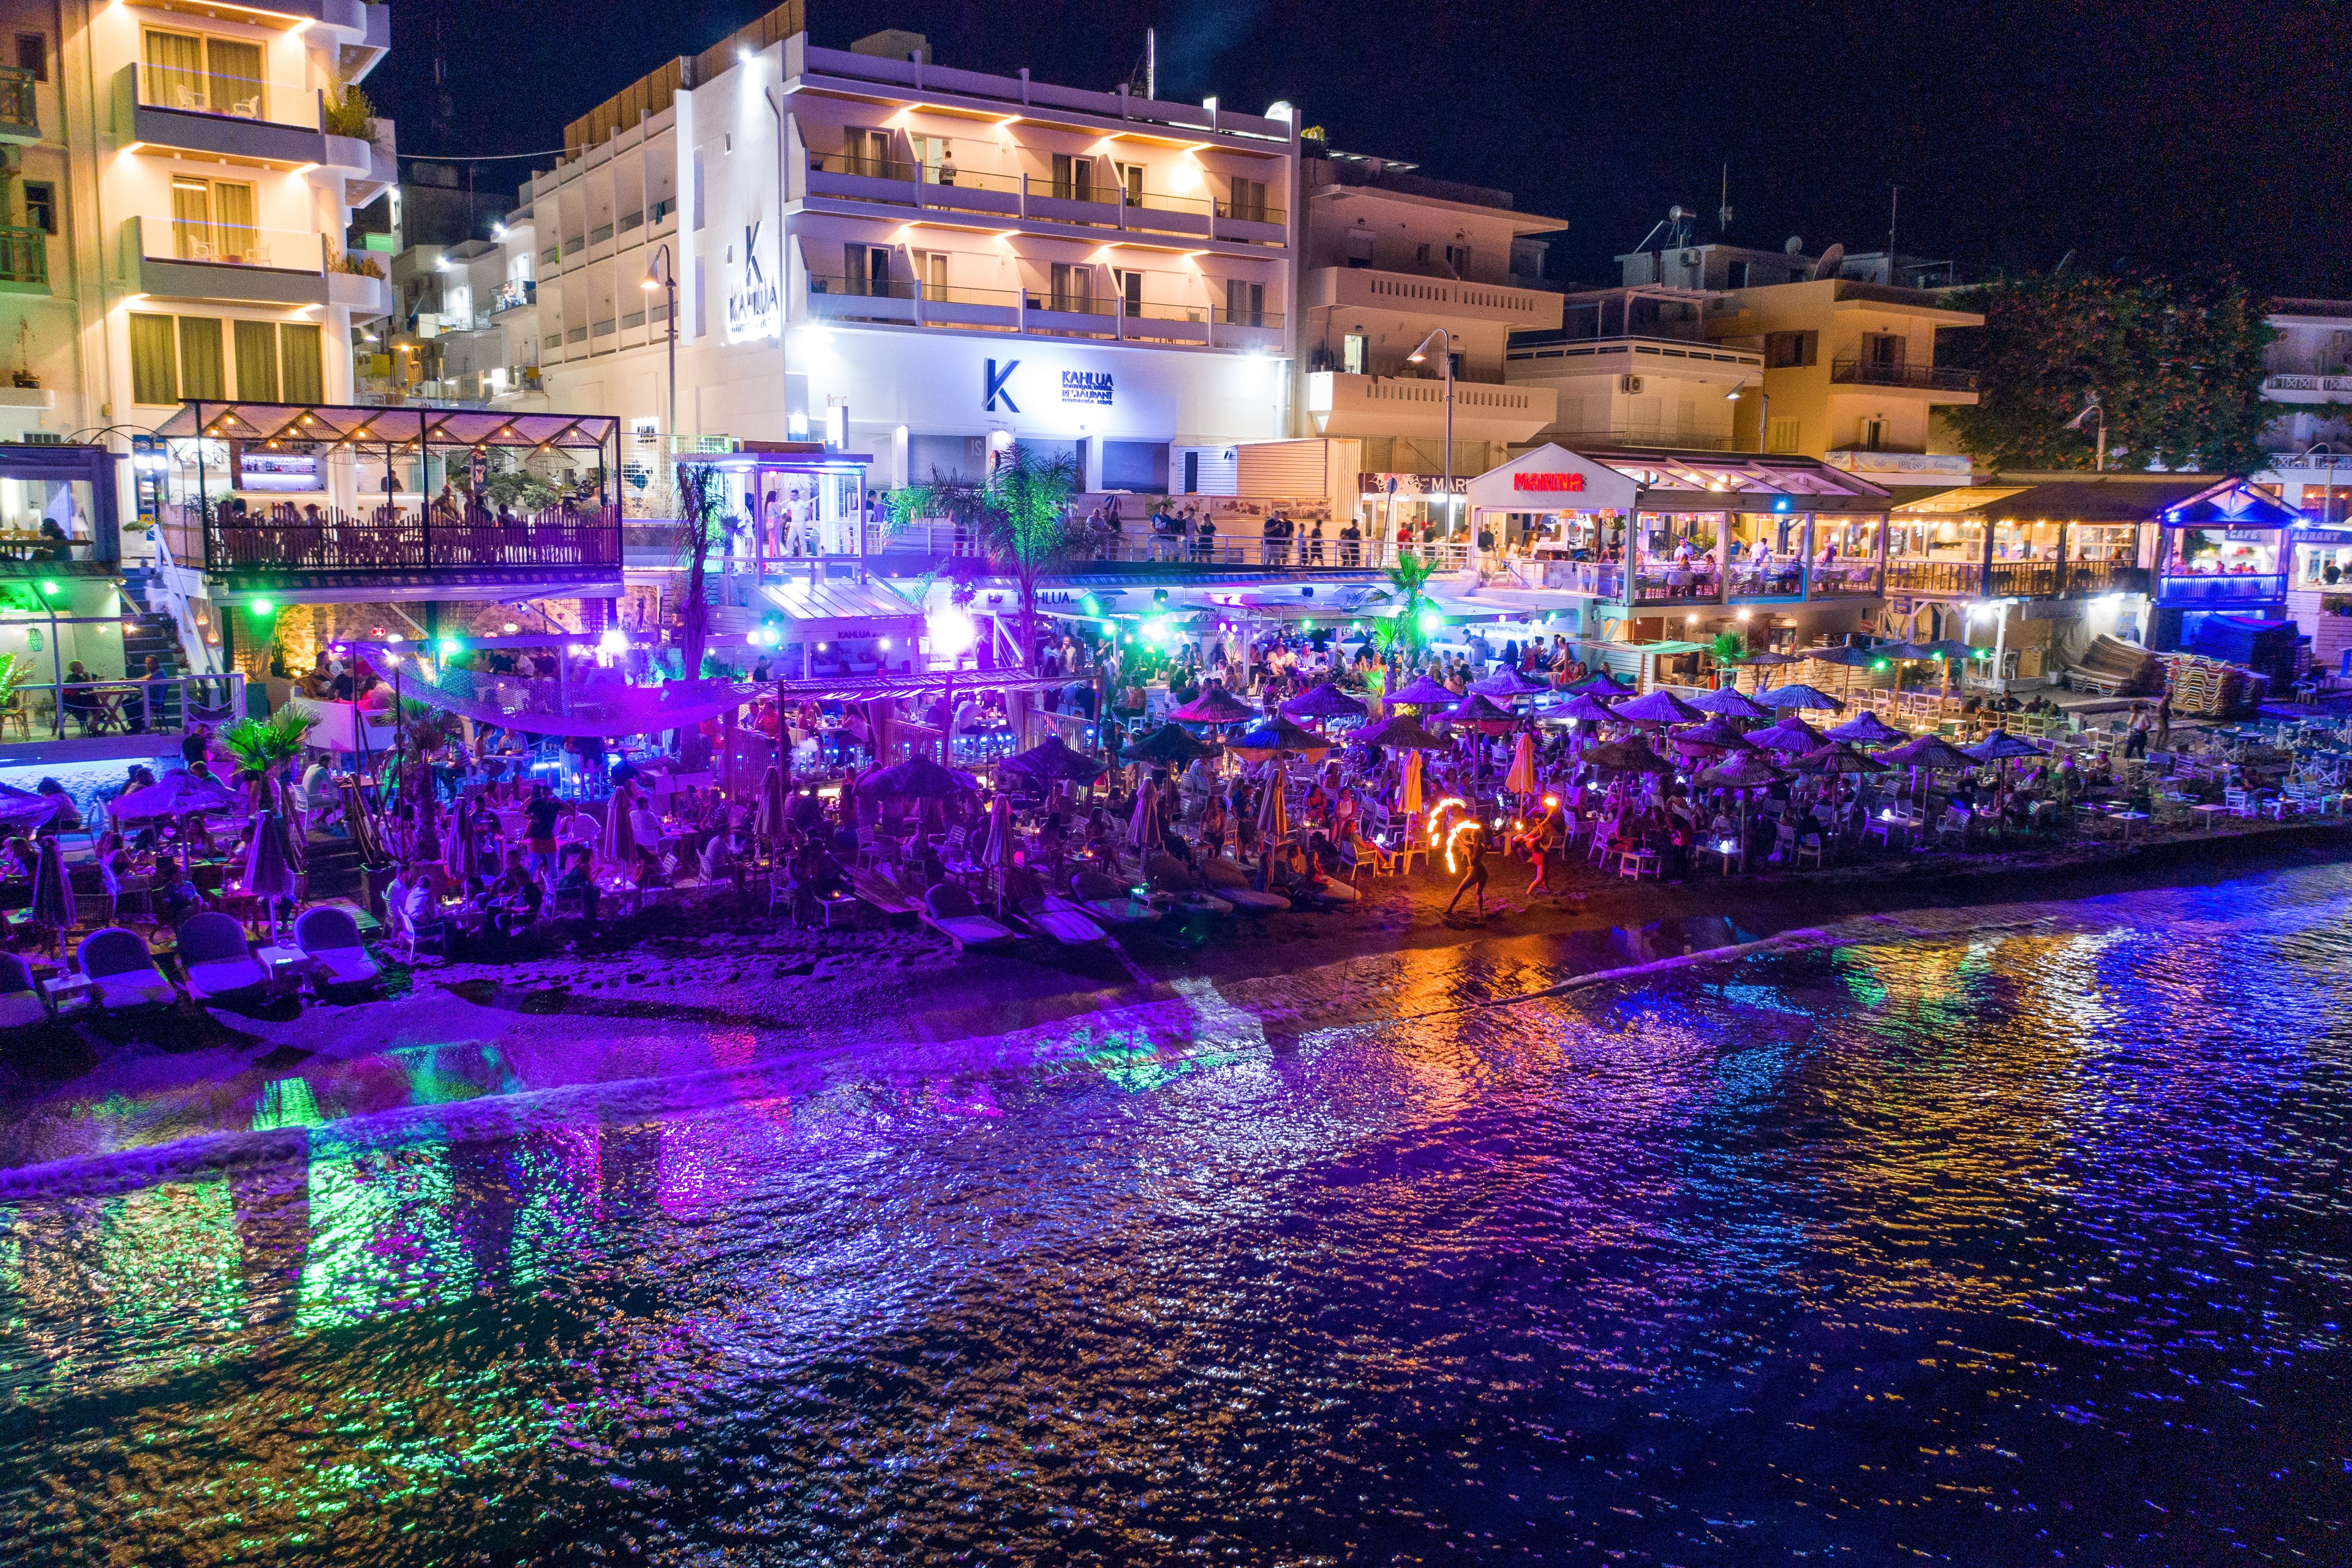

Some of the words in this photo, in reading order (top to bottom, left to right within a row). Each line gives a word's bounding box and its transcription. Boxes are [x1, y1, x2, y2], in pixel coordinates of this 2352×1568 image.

[745, 221, 763, 287] K
[981, 358, 1021, 413] K
[1061, 370, 1114, 386] KAHLUA
[1513, 472, 1582, 492] MARINA
[1017, 590, 1070, 605] KHLUA
